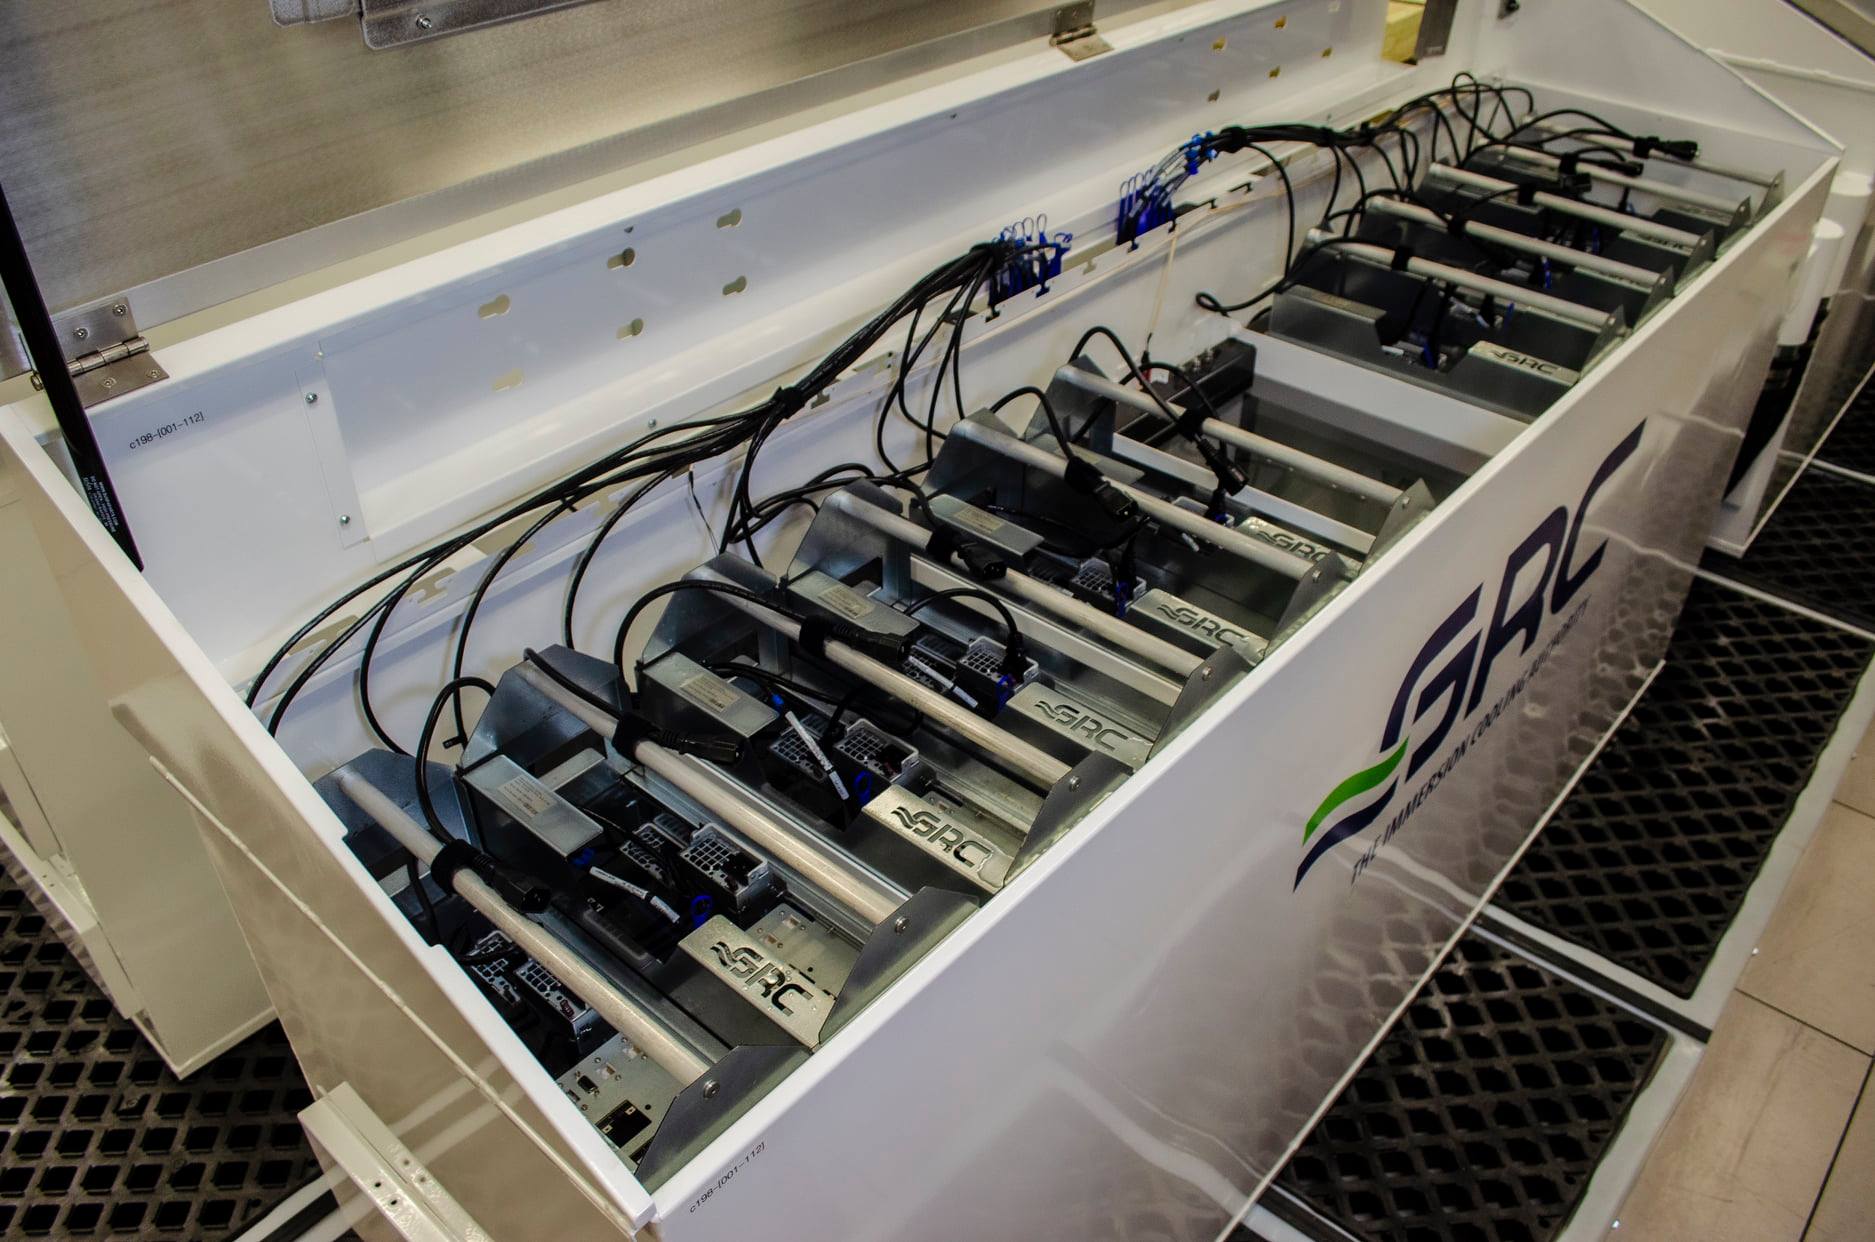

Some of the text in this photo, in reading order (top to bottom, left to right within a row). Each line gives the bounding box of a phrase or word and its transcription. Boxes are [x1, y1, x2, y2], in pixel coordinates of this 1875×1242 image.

[1175, 608, 1248, 647] GRC
[1380, 418, 1647, 784] GRC
[1055, 704, 1129, 752] GRC
[1350, 835, 1381, 887] THE
[1382, 735, 1470, 846] IMMERSION
[1470, 671, 1529, 747] COOLING
[913, 811, 991, 868] GRC
[730, 947, 814, 1017] GRC
